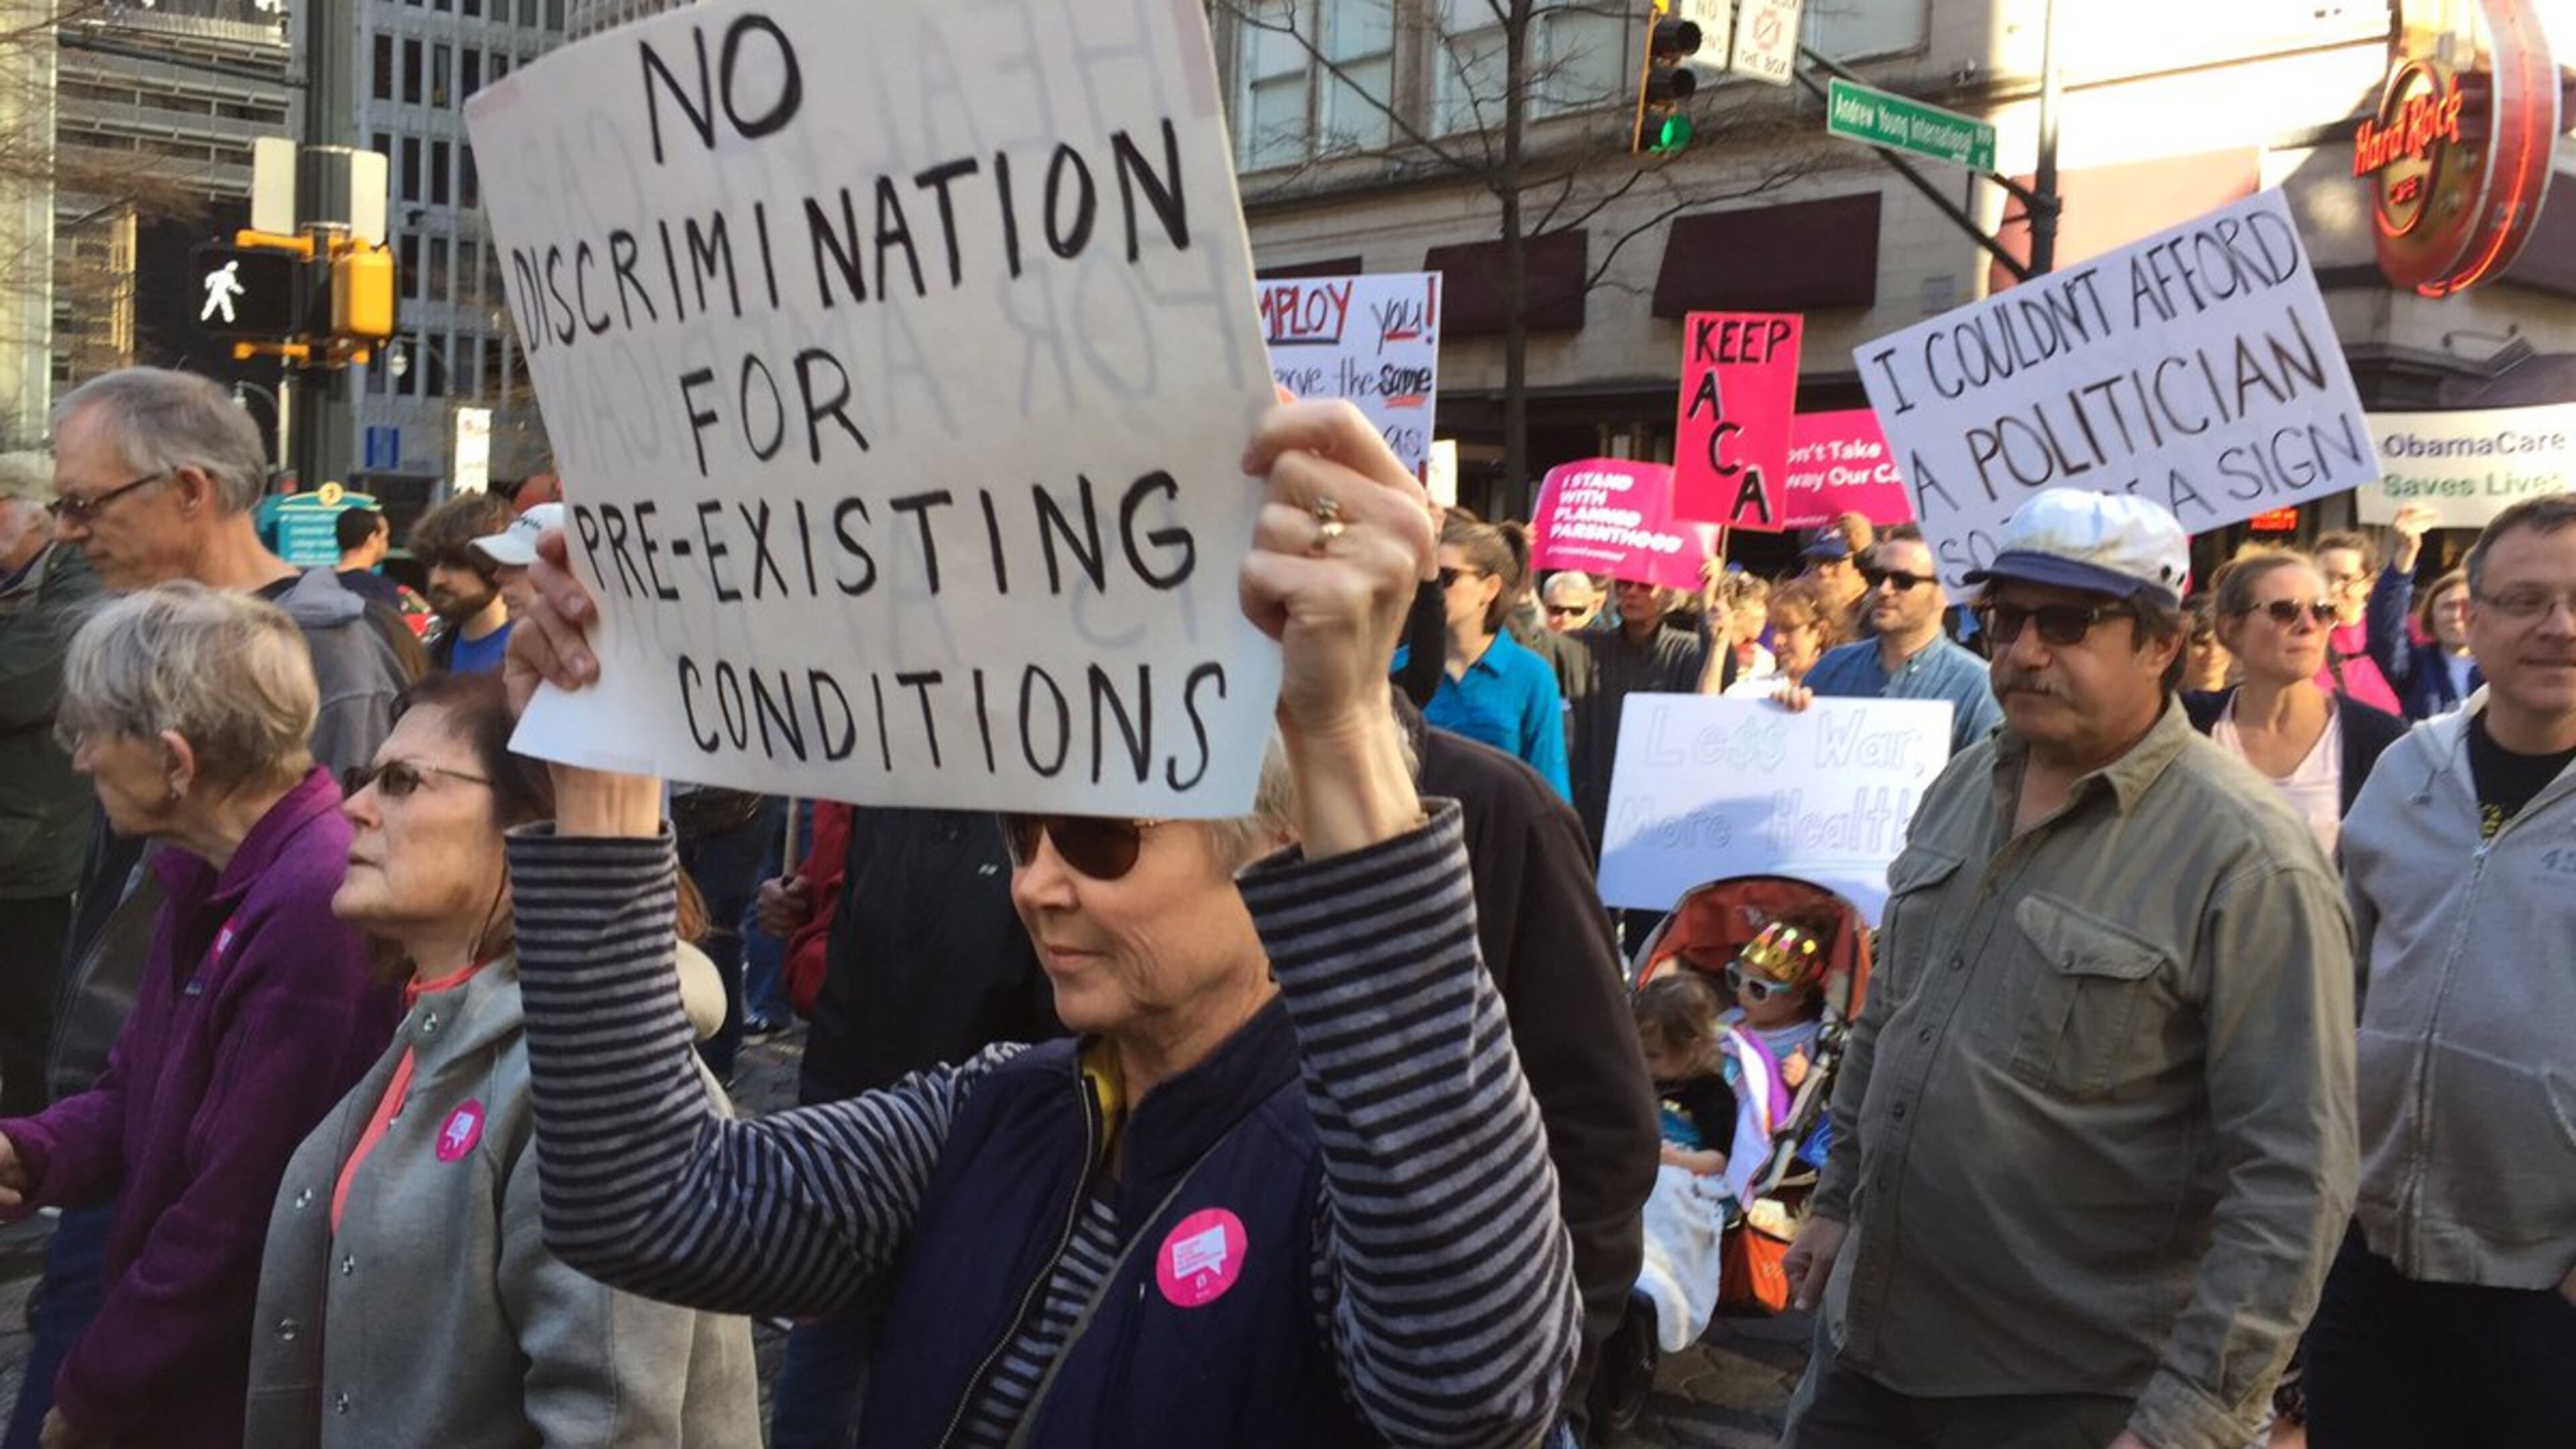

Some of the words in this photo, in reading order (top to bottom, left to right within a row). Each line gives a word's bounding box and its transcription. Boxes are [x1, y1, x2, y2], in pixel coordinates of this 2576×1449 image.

[639, 13, 803, 165] NO
[1833, 91, 1875, 128] Andrew
[1878, 103, 1909, 146] Young
[1911, 113, 1974, 155] International
[2353, 101, 2408, 178] Hard
[2405, 72, 2464, 161] Rock
[512, 117, 1191, 352] DISCRIMINATION
[1695, 318, 1792, 364] KEEP
[1874, 348, 1915, 416] I
[2130, 209, 2299, 329] AFFORD
[1333, 356, 1377, 397] the
[1378, 363, 1432, 397] same
[680, 347, 870, 477] FOR
[1910, 448, 1961, 522] A
[1966, 306, 2326, 502] POLITICIAN
[1827, 438, 1882, 461] Take
[2167, 468, 2217, 519] A
[2217, 412, 2364, 501] SIGN
[2383, 430, 2567, 458] ObamaCare
[1559, 488, 1609, 506] WITH
[1561, 474, 1570, 490] I
[1571, 471, 1635, 492] STAND
[1827, 466, 1872, 487] Our
[2383, 472, 2477, 497] Saves
[574, 470, 1197, 602] PRE-EXISTING
[1549, 522, 1685, 554] PARENTHOOD
[1552, 506, 1643, 529] PLANNED
[678, 654, 1228, 792] CONDITIONS
[1617, 794, 1734, 857] More
